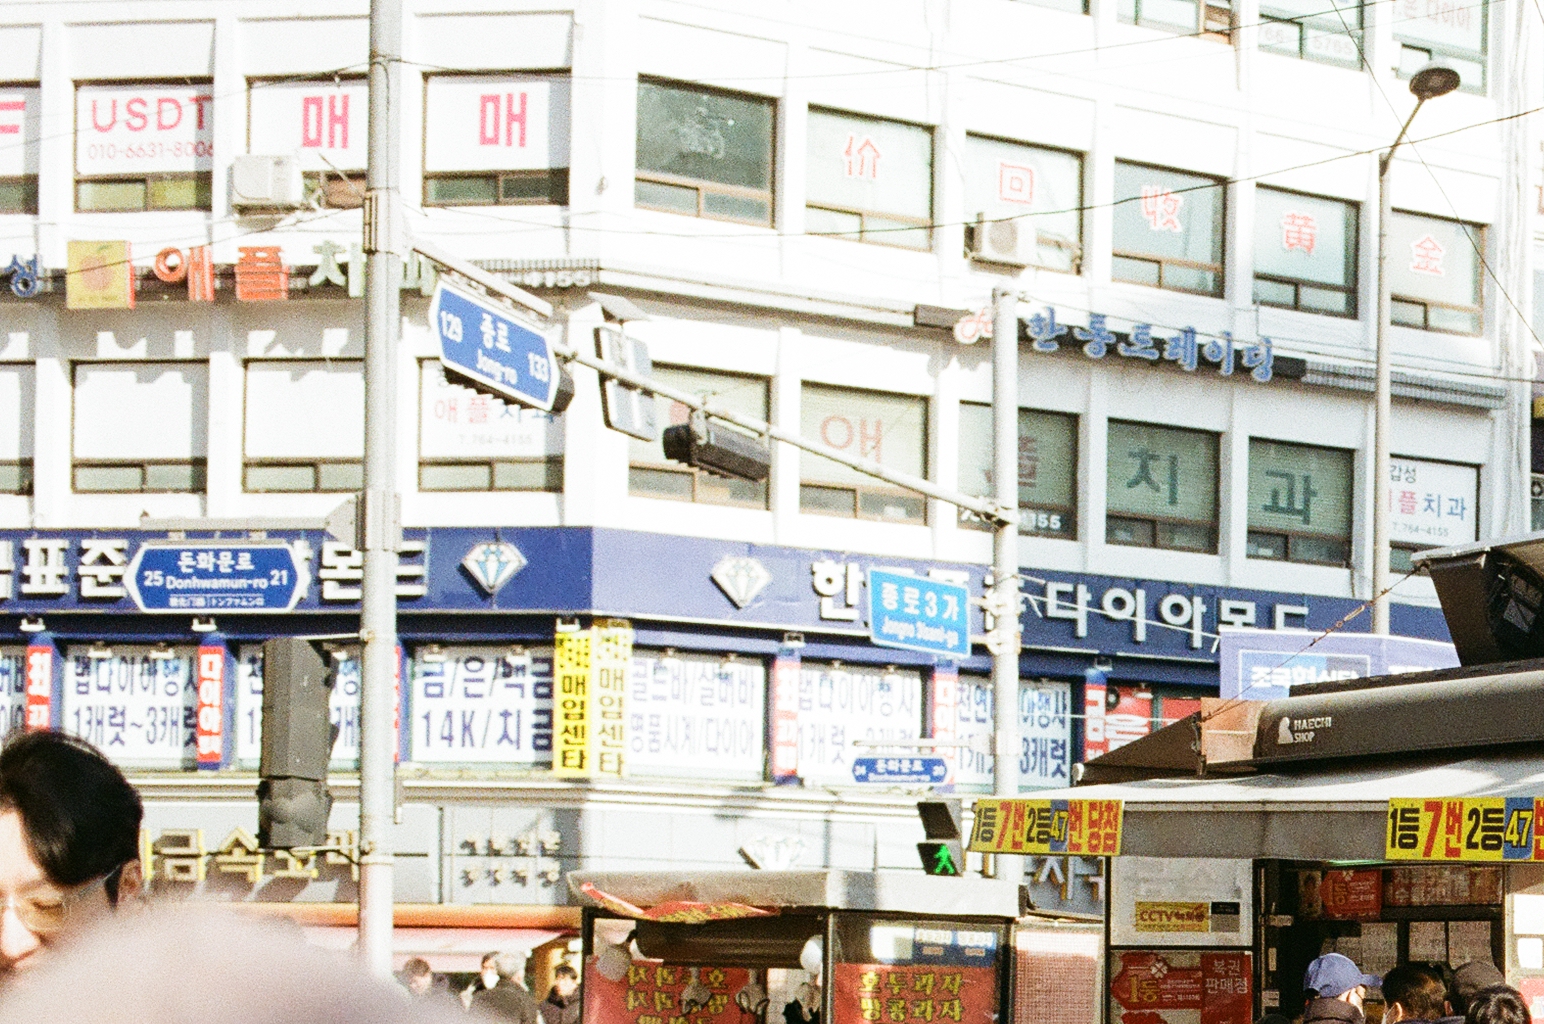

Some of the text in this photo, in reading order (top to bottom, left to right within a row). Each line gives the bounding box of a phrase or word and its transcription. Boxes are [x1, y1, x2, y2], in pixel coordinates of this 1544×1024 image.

[92, 95, 213, 132] USDT
[302, 92, 528, 149] 매 매
[844, 135, 881, 179] 价
[999, 162, 1034, 204] 回
[1410, 235, 1445, 275] 金
[440, 310, 463, 343] 129
[480, 312, 511, 352] 종로
[528, 352, 550, 383] 133
[820, 415, 883, 464] 애
[1127, 446, 1318, 525] 치 과
[1389, 488, 1467, 521] 플치과
[143, 570, 163, 586] 25
[177, 551, 255, 573] 돈화문로
[270, 569, 288, 586] 21
[165, 576, 268, 589] Donhwamun-ro
[881, 582, 959, 621] 종로3가
[560, 674, 587, 770] 매입센타
[598, 667, 626, 775] 매입센타
[1294, 715, 1332, 731] HAECHI
[1294, 731, 1315, 744] SHOP
[974, 807, 997, 843] 1등
[996, 801, 1027, 850] 7번
[1026, 807, 1050, 844] 2등
[1087, 801, 1120, 853] 당첨
[1389, 806, 1420, 850] 1등
[1423, 801, 1463, 858] 7번
[1466, 806, 1504, 850] 2등
[859, 970, 962, 996] 호두과자
[1213, 960, 1241, 977] 복권
[1127, 974, 1159, 1003] 1등
[1206, 977, 1248, 994] 판매점
[860, 997, 964, 1022] 땅콩과자
